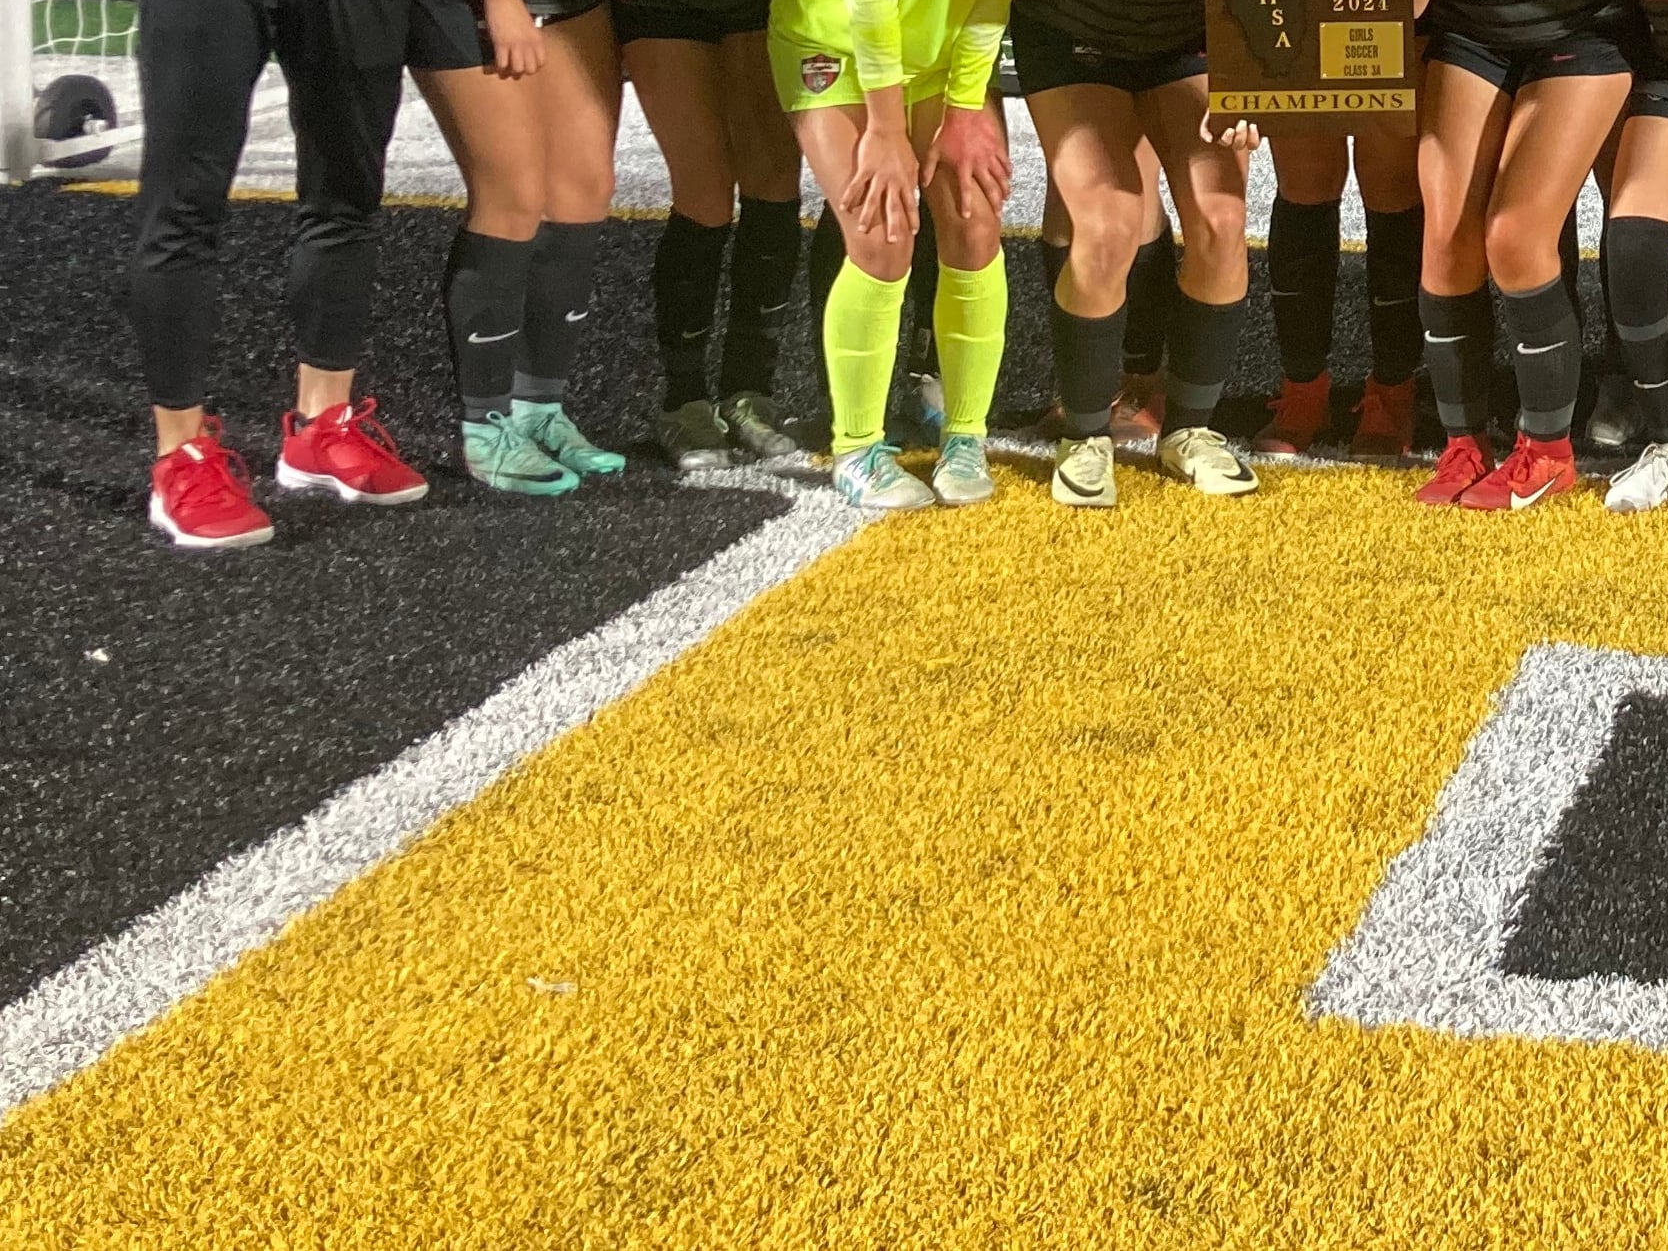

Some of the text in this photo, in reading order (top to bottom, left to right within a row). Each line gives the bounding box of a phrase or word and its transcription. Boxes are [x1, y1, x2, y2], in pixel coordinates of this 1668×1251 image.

[1349, 28, 1374, 42] GIRLS
[1345, 45, 1379, 59] SOCCER
[1343, 64, 1382, 77] CLASS 3A
[1221, 93, 1404, 111] CHAMPIONS
